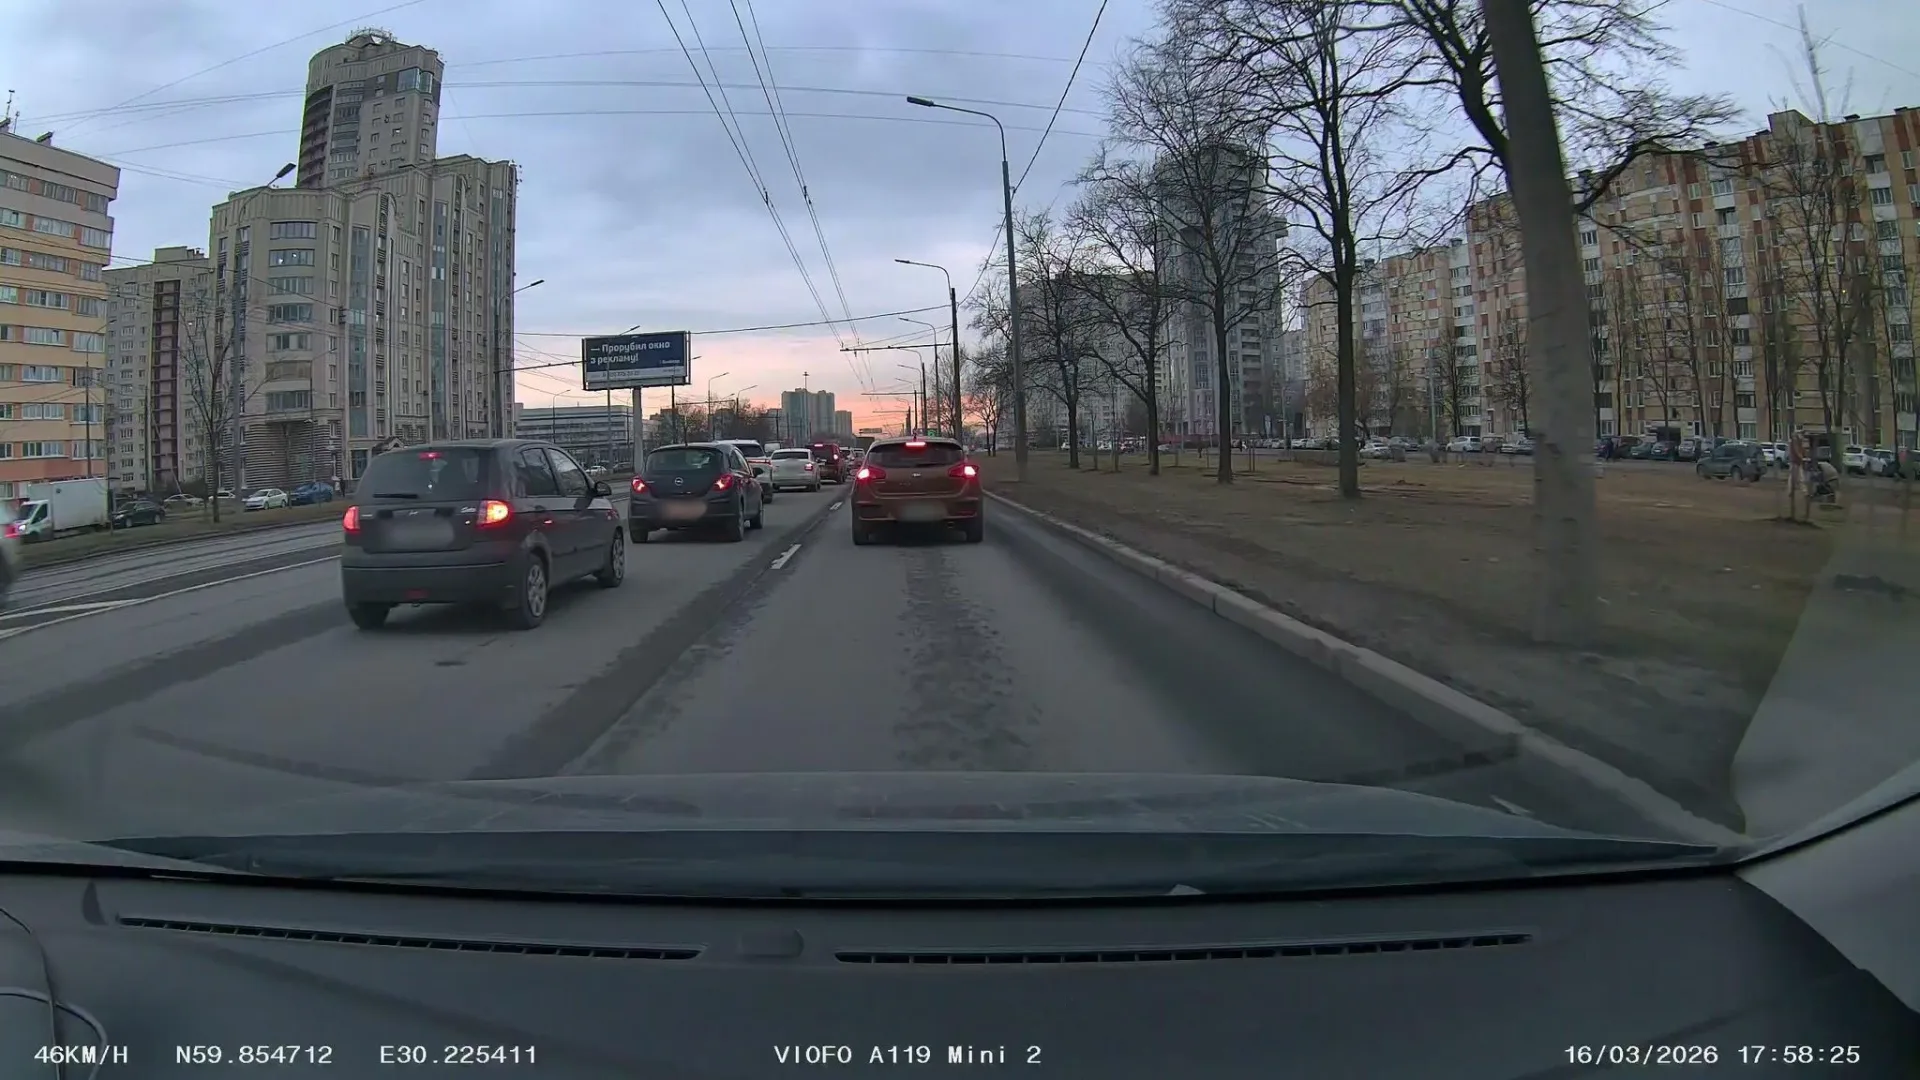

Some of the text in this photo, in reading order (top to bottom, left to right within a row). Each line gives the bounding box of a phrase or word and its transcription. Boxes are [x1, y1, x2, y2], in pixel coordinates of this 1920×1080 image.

[602, 342, 647, 354] Прорубил
[648, 341, 670, 349] окно
[597, 353, 639, 365] рекламу!
